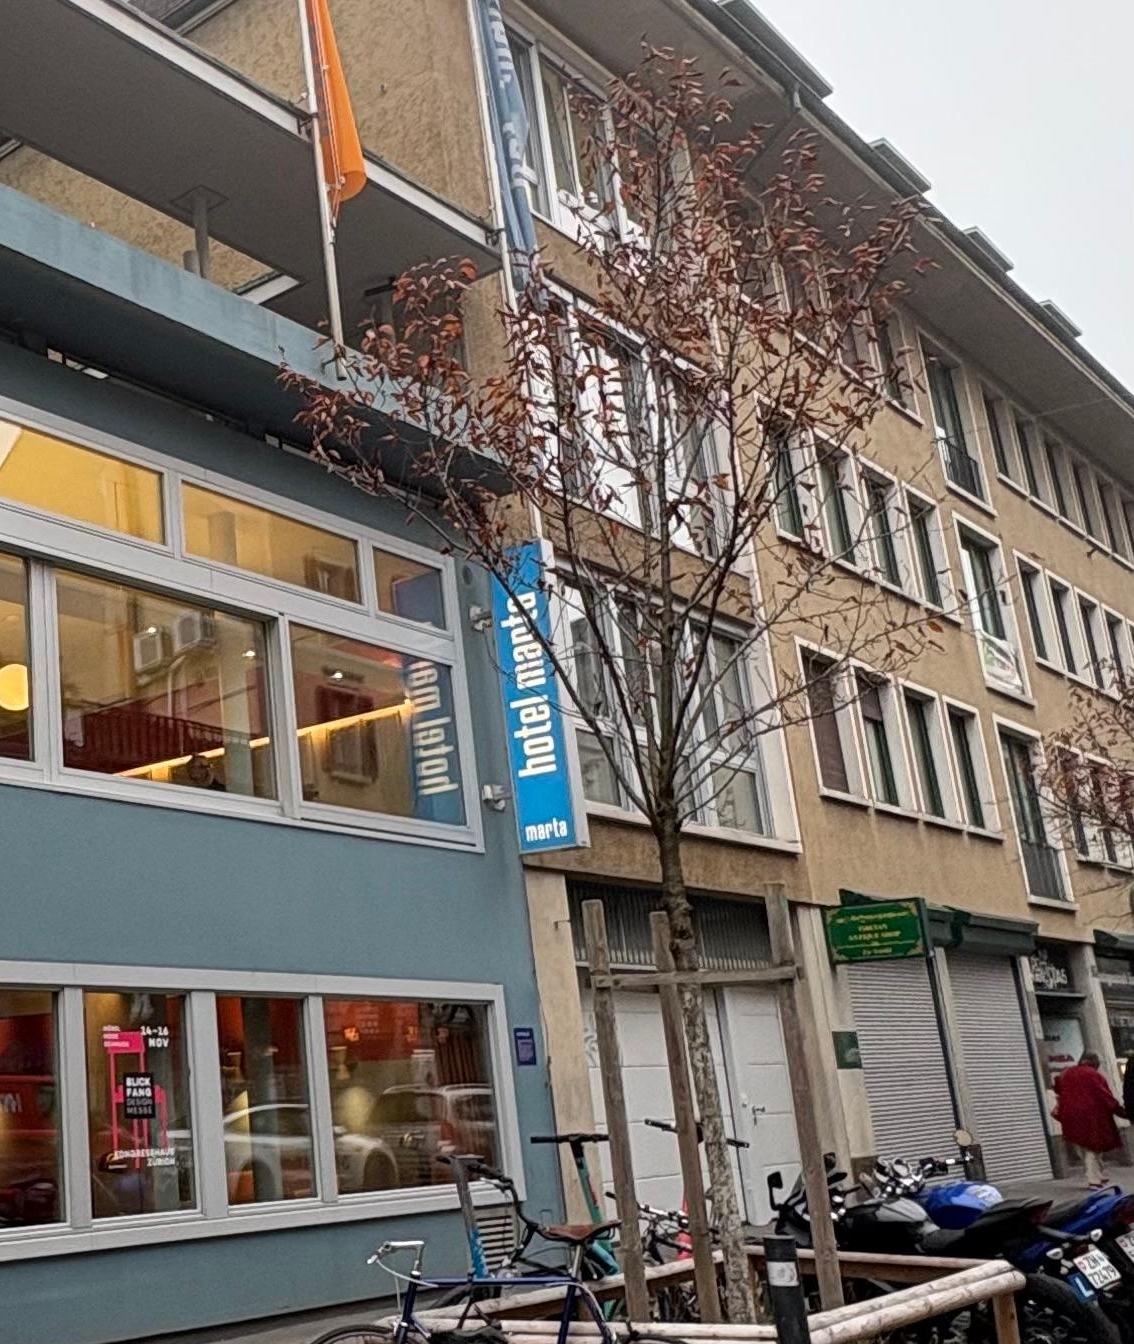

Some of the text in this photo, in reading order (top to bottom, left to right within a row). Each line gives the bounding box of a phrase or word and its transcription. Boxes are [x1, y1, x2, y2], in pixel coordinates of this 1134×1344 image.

[500, 590, 558, 778] hotel marta
[524, 817, 568, 843] marta
[148, 1037, 170, 1048] NOV
[125, 1077, 151, 1087] BLICK
[125, 1087, 152, 1097] FANG
[1073, 1276, 1095, 1298] L
